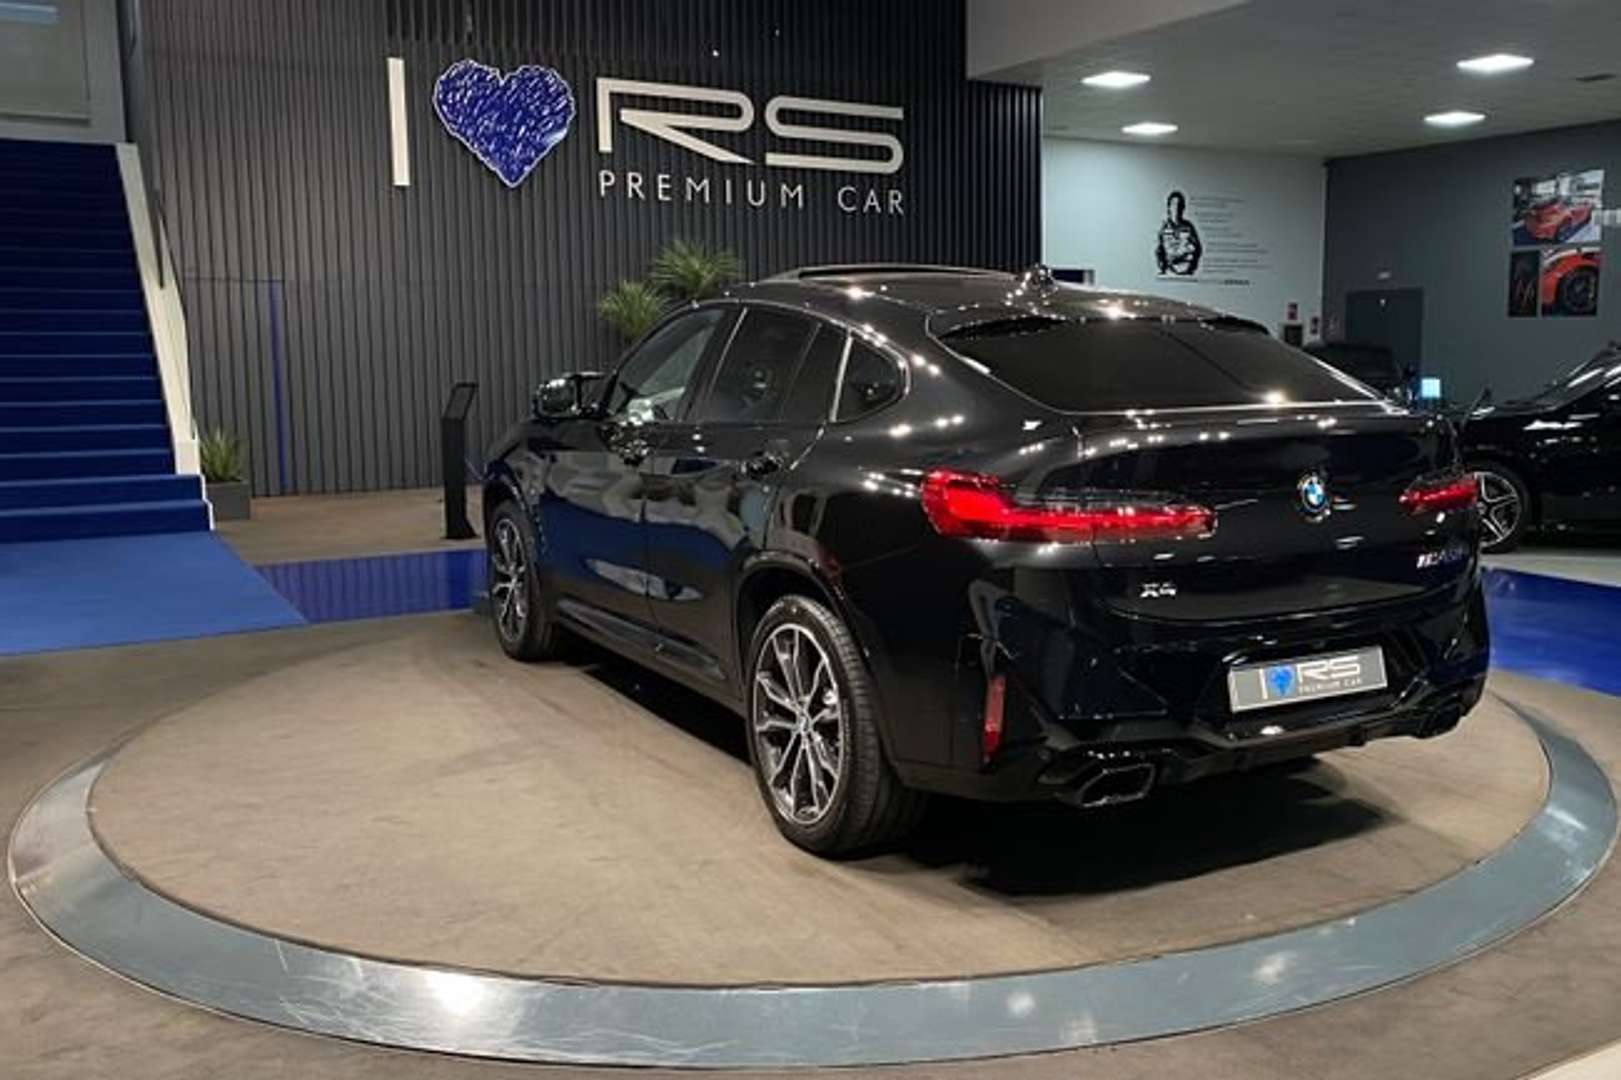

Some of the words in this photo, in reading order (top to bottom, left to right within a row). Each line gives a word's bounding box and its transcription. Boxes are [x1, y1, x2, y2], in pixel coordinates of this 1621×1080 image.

[596, 77, 904, 175] RS
[599, 170, 804, 209] PREMIUM
[837, 186, 905, 215] CAR
[1296, 655, 1361, 683] RS
